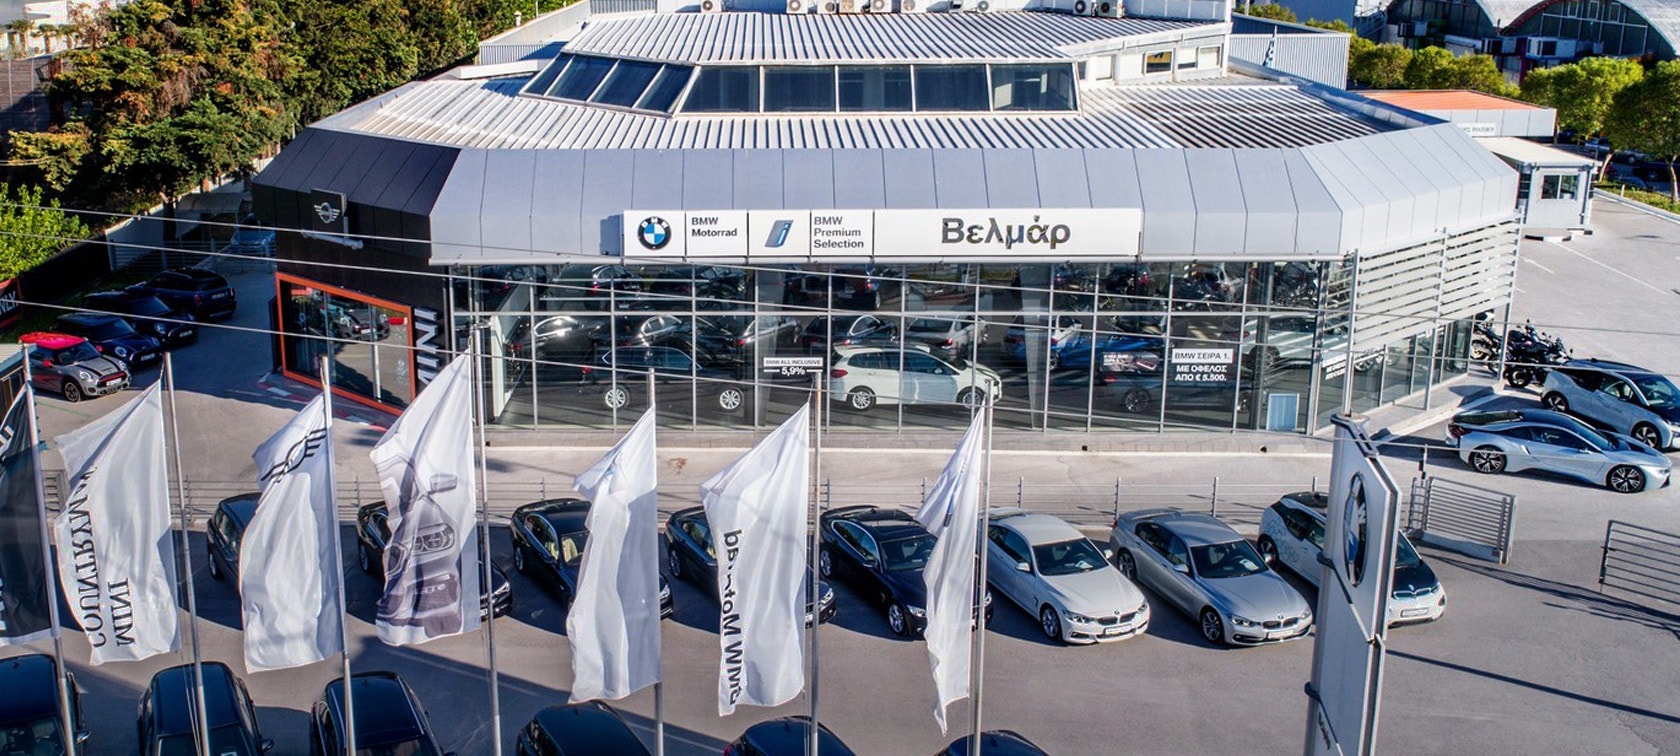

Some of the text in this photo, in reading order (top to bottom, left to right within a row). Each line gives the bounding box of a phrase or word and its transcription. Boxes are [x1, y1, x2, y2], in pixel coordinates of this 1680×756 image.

[691, 217, 719, 226] BMW
[814, 216, 843, 226] BMW
[691, 228, 738, 237] Motorrad
[814, 228, 862, 237] Premium
[941, 214, 1071, 250] Βελμάρ
[813, 239, 864, 249] Selection
[1174, 352, 1196, 360] BMW
[1197, 352, 1221, 360] ΣΕΙΡΑ
[781, 366, 806, 376] 5,9%
[1176, 364, 1228, 373] ΜΕ ΟΦΕΛΟΣ
[1174, 373, 1195, 382] ΑΠΟ
